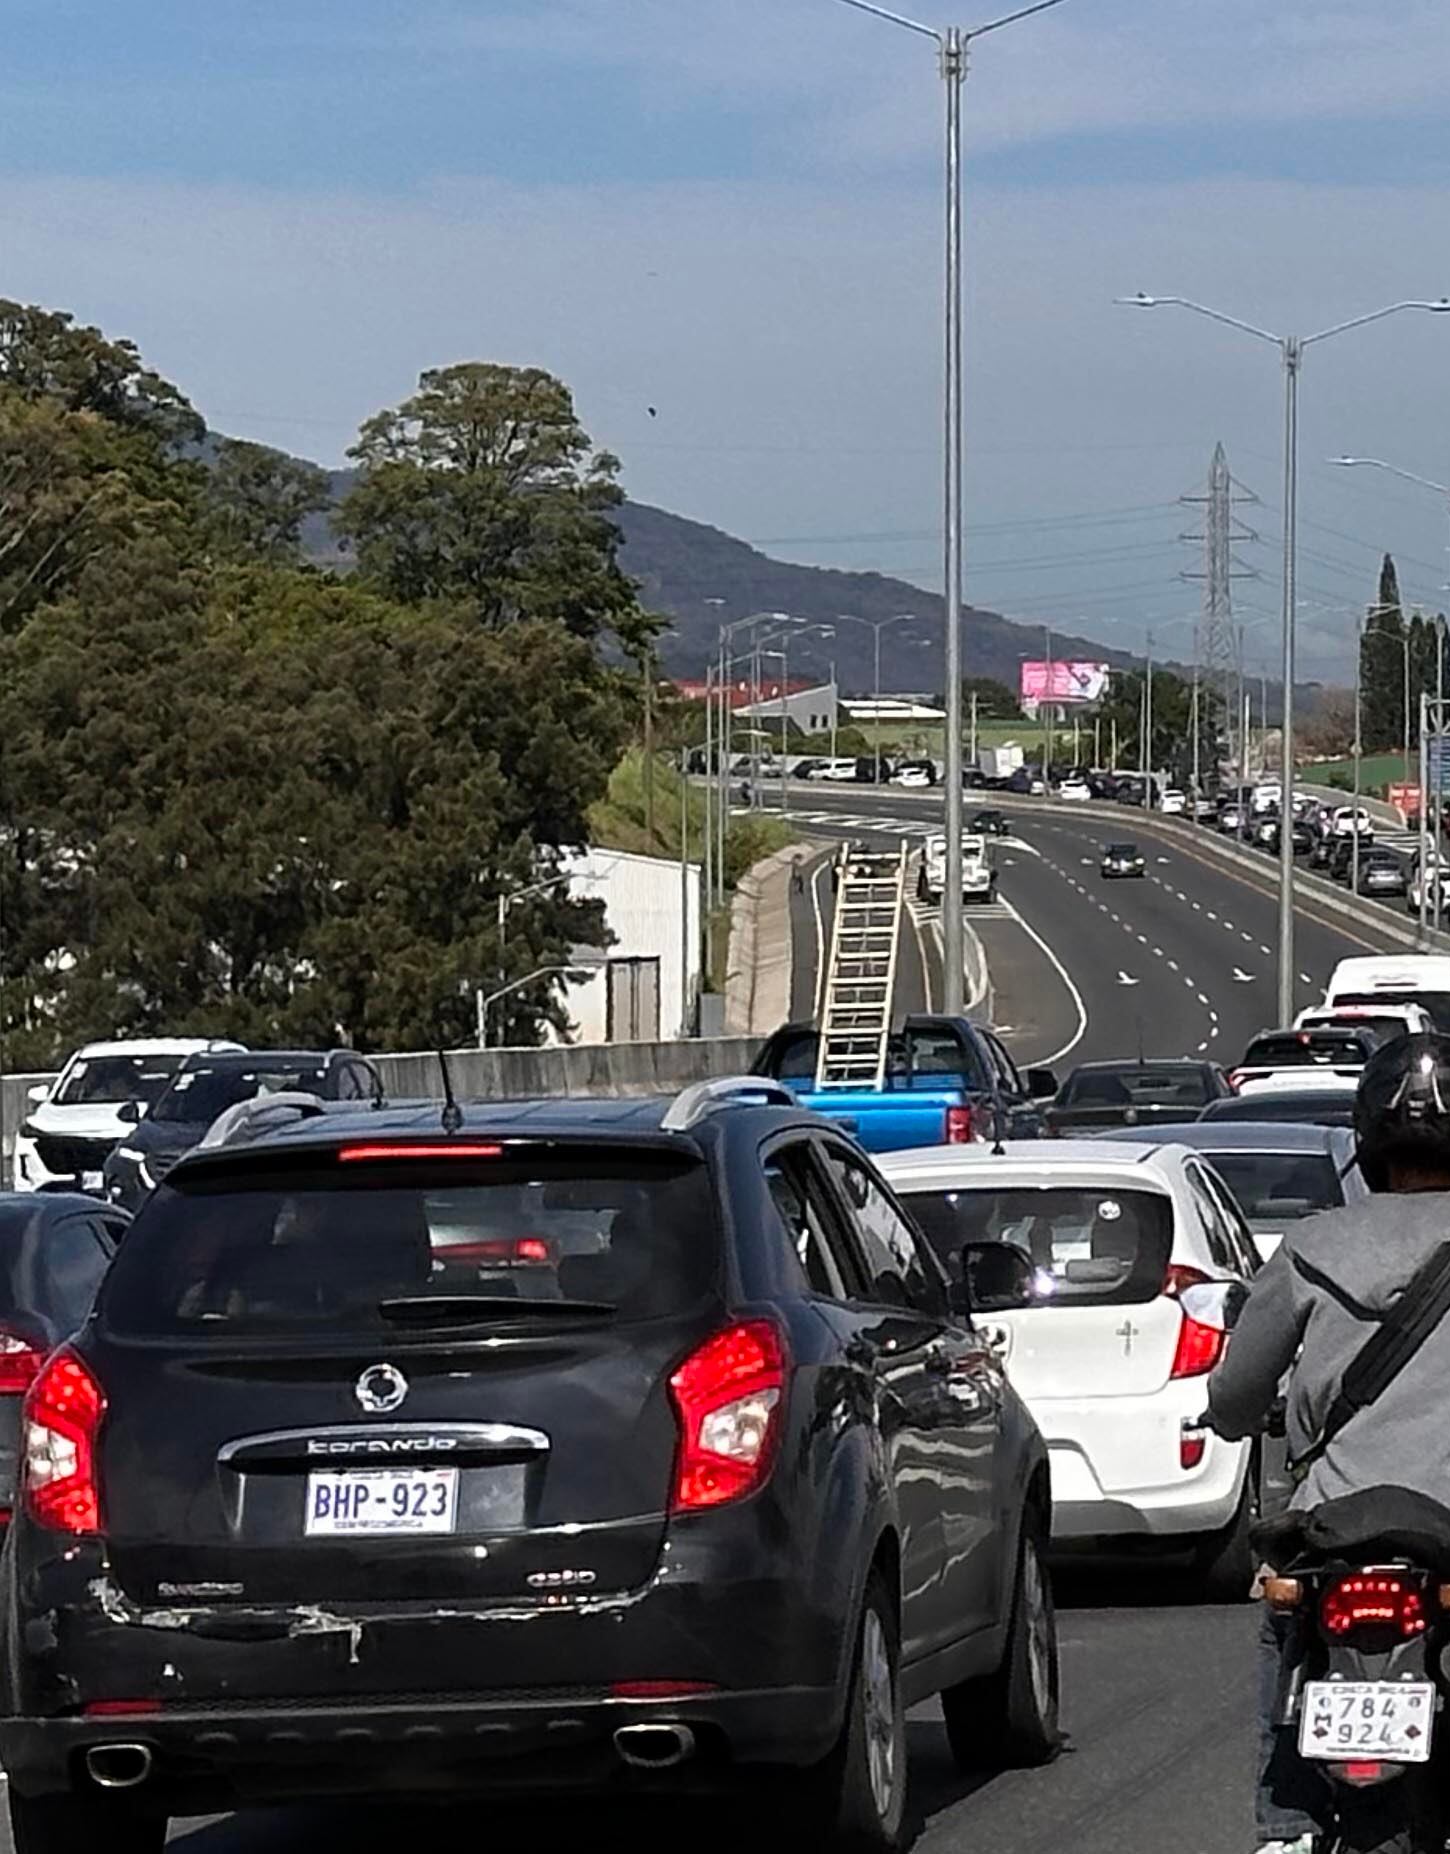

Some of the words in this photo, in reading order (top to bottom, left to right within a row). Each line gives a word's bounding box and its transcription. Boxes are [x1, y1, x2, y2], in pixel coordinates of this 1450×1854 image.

[314, 1482, 449, 1519] BHP-923
[1339, 1697, 1396, 1719] 784
[1337, 1723, 1394, 1745] 924
